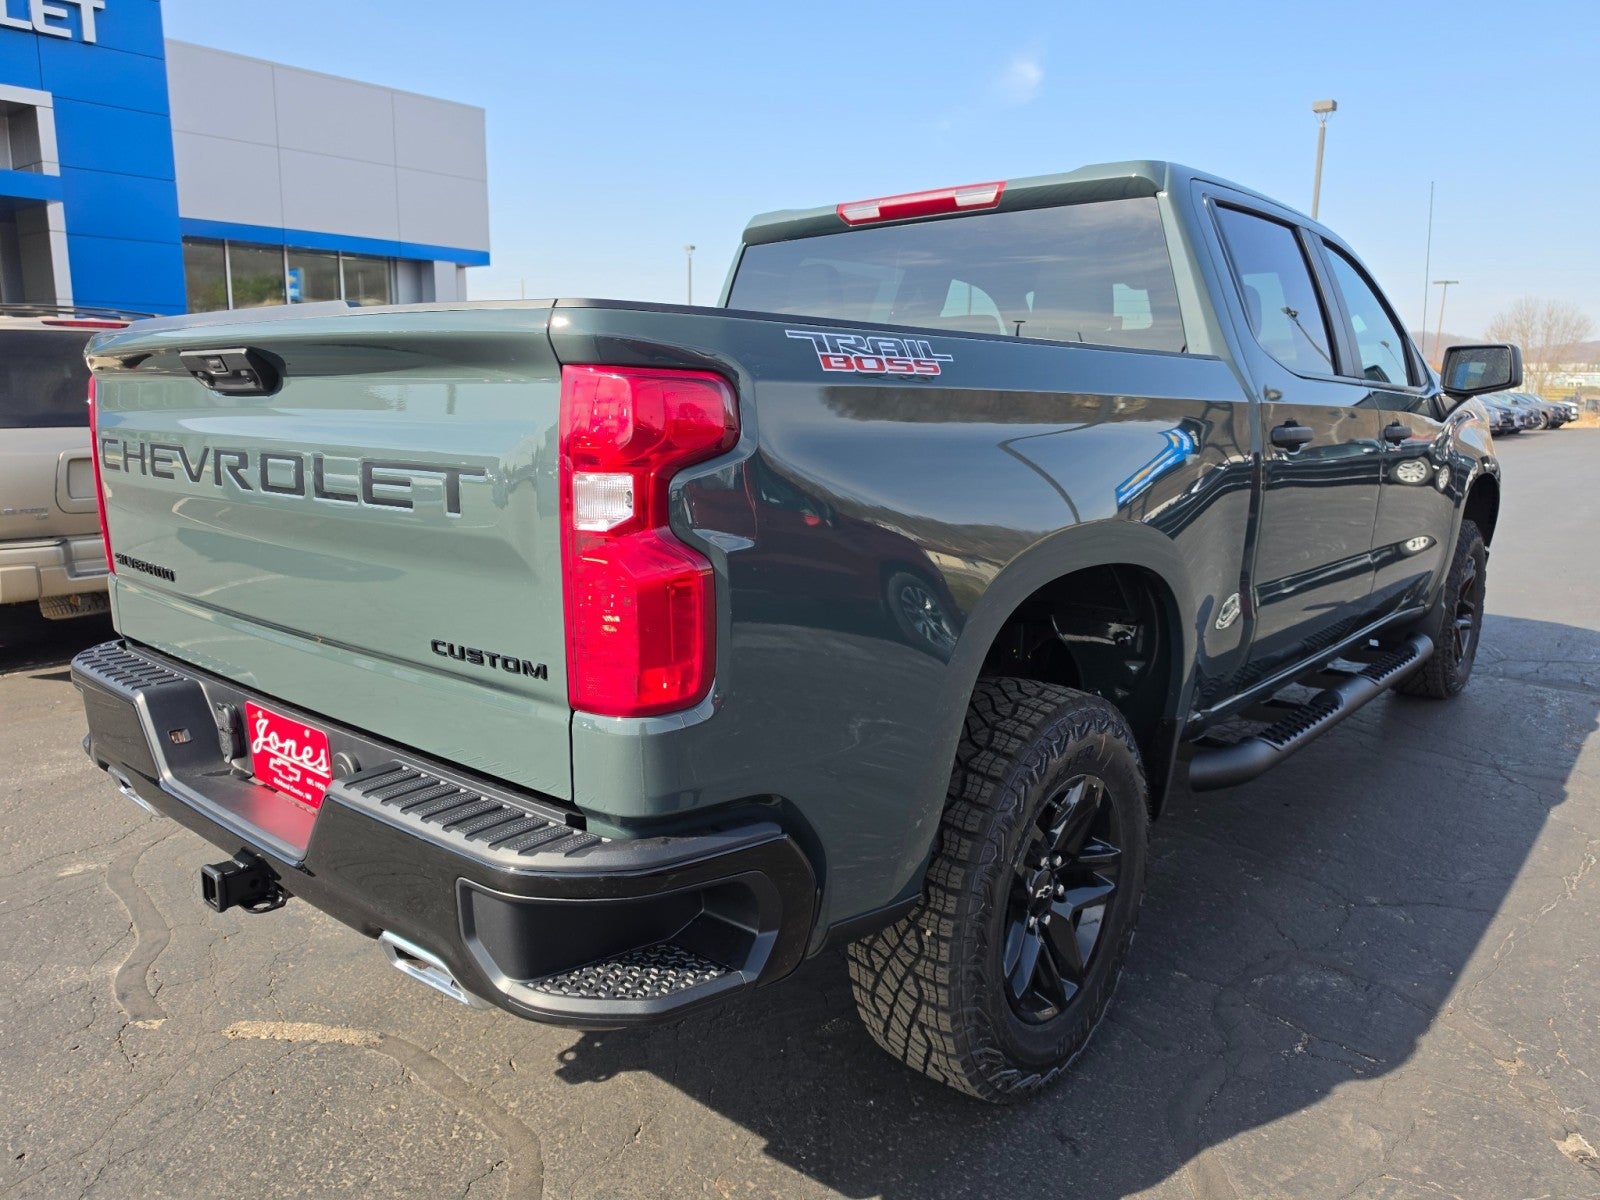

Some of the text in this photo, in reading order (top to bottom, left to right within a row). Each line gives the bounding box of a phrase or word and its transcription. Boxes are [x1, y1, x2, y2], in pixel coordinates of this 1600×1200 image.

[785, 329, 953, 361] TRAIL
[819, 353, 941, 375] BOSS
[101, 438, 489, 518] CHEVROLET
[430, 638, 548, 681] CUSTOM
[252, 718, 329, 772] Jones
